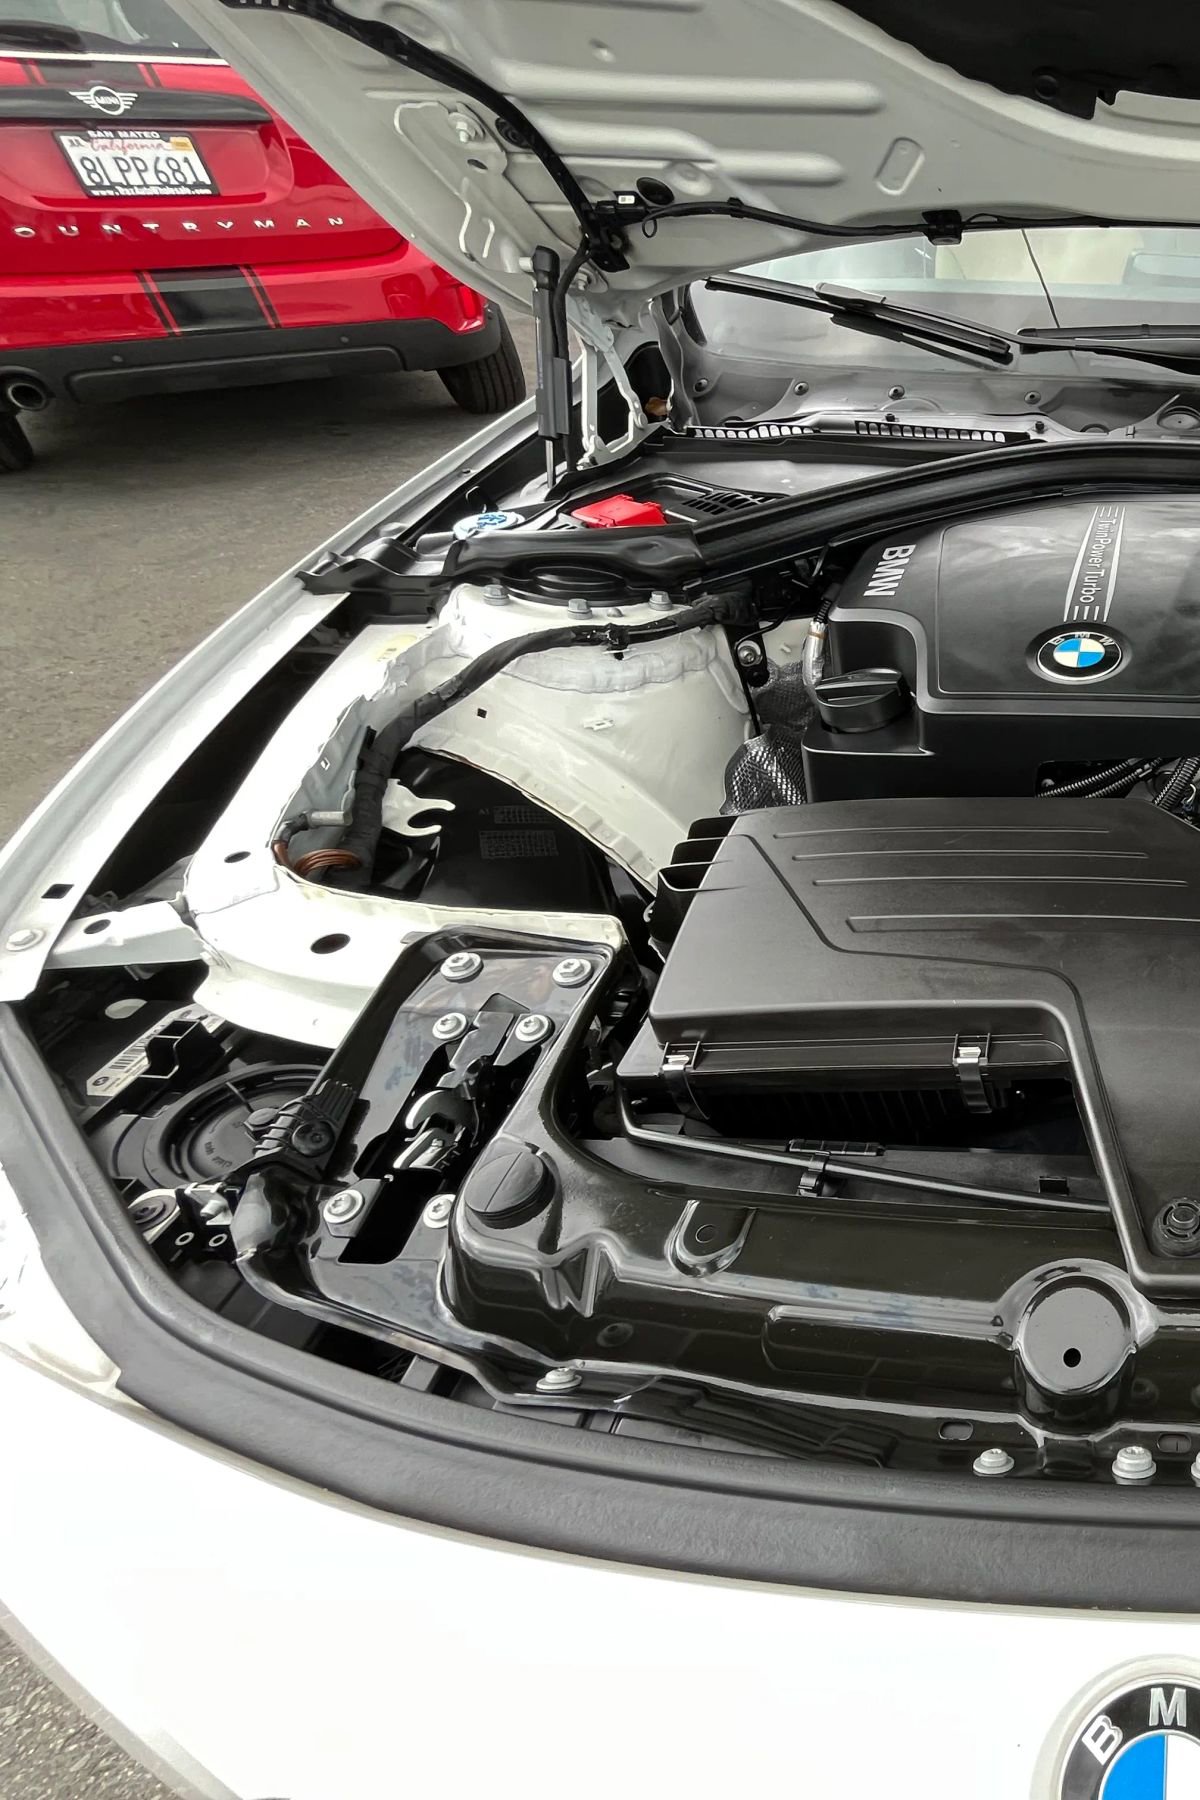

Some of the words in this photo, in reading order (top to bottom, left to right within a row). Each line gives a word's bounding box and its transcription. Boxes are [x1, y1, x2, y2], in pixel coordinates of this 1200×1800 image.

[89, 139, 171, 154] California
[80, 156, 207, 186] 8LPP681
[1086, 518, 1117, 568] TwinPower
[863, 544, 917, 597] BMW
[1080, 569, 1106, 603] Turbo
[1049, 632, 1116, 647] BMW
